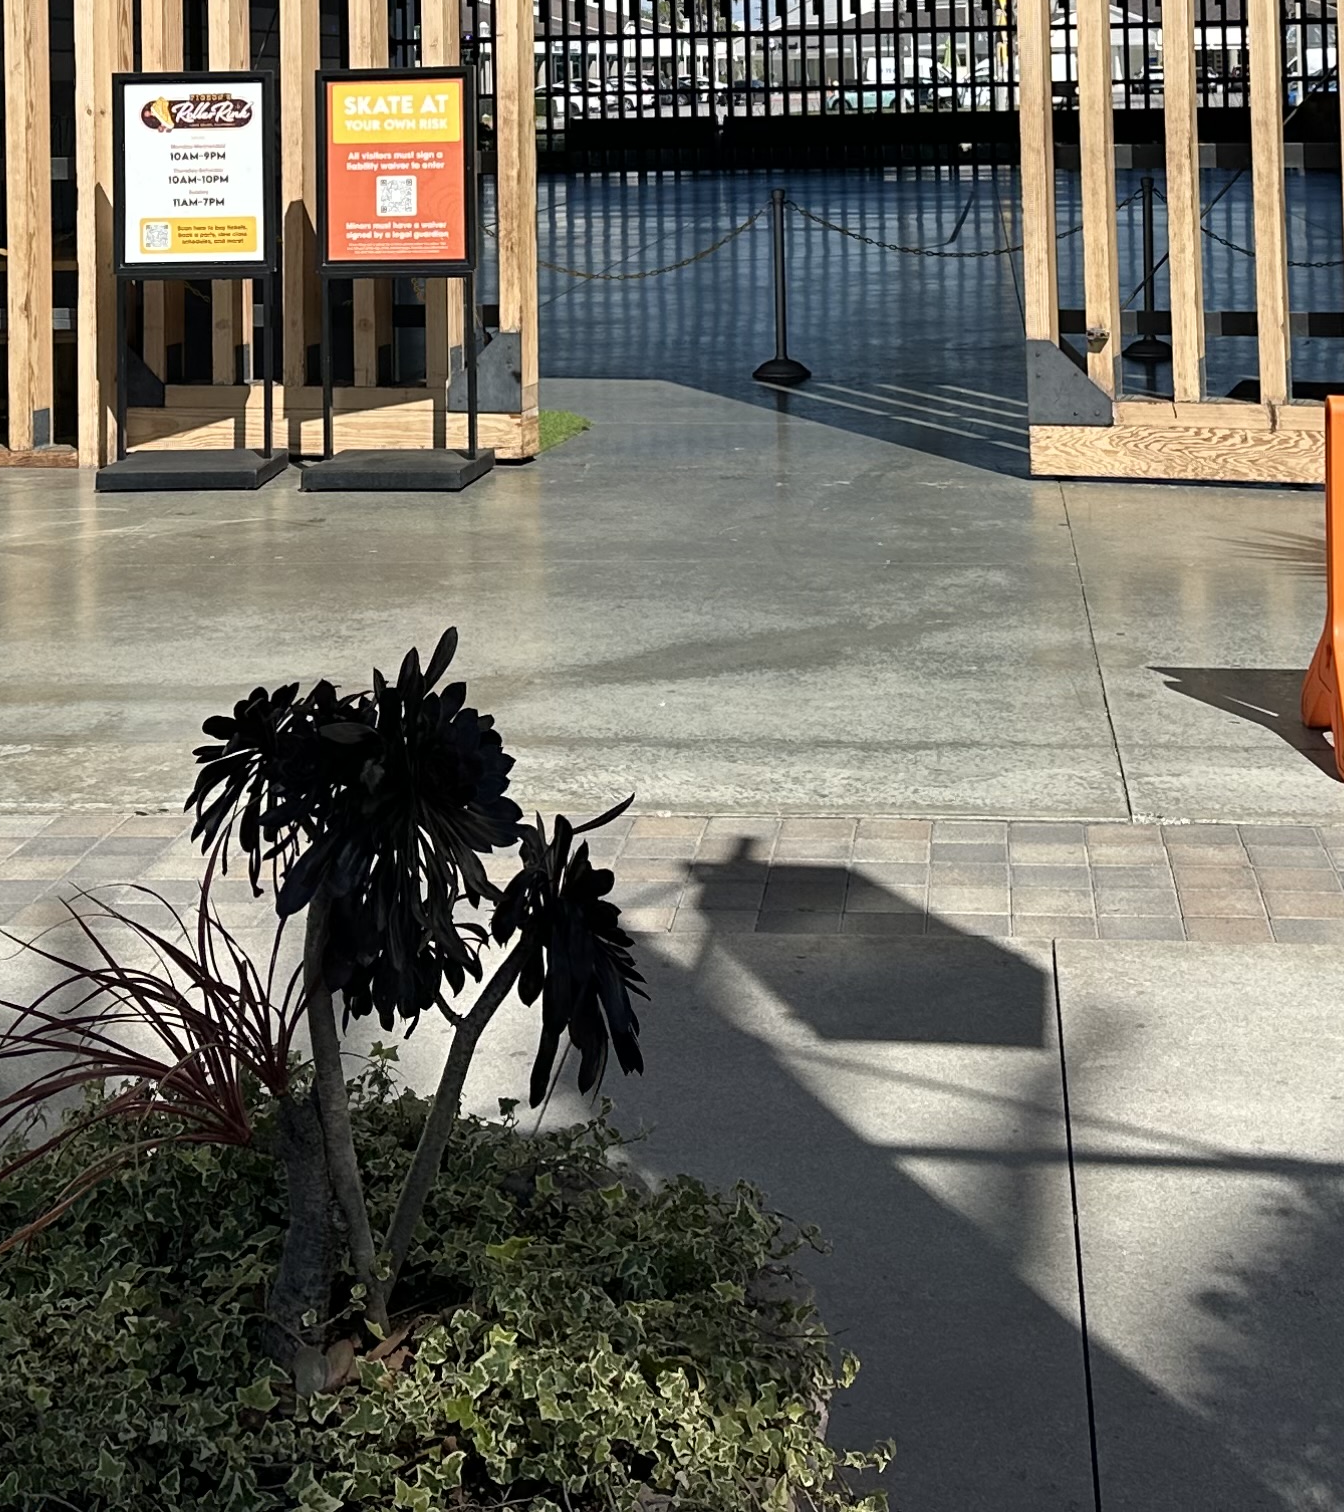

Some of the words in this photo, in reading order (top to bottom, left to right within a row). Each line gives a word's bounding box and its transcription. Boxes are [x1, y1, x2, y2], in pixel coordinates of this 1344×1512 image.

[344, 95, 413, 115] SKATE
[420, 94, 449, 113] AT
[345, 119, 381, 131] YOUR
[383, 118, 416, 130] OWN
[419, 118, 448, 129] RISK
[170, 151, 226, 161] 10AM-9PM
[348, 152, 360, 160] All
[361, 152, 392, 160] visitors
[393, 151, 414, 159] must
[416, 151, 435, 161] sign
[168, 175, 229, 184] 10AM-10PM
[173, 198, 225, 207] 11AM-7PM
[392, 231, 413, 239] legal
